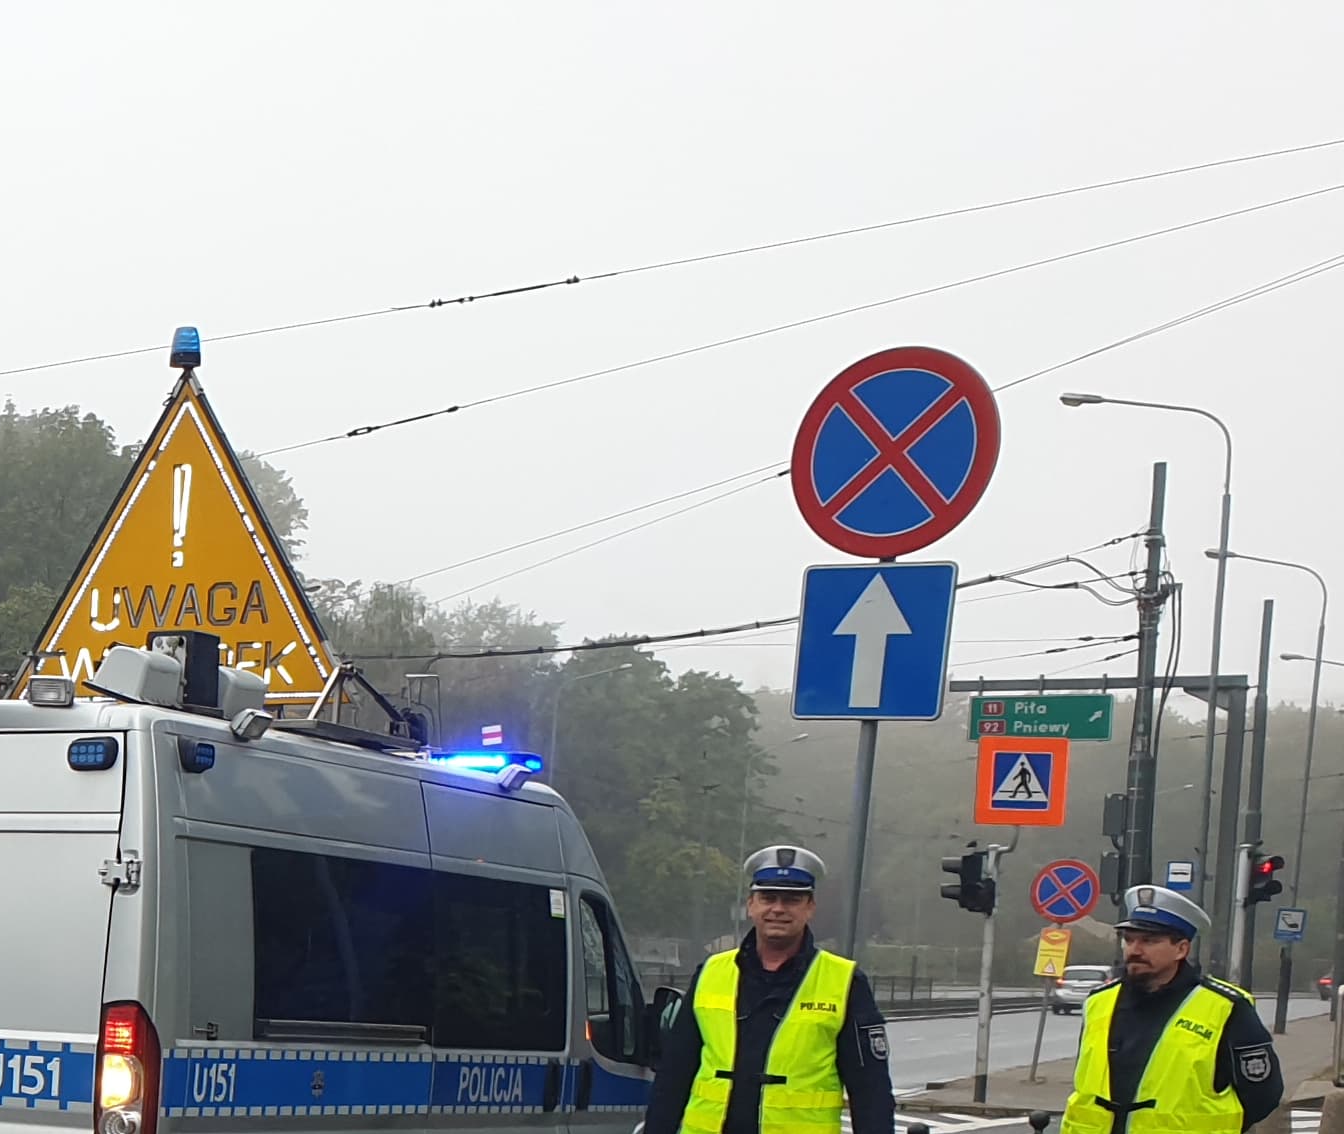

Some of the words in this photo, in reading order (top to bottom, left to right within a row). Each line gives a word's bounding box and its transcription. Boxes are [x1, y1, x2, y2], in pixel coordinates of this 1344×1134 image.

[90, 580, 269, 632] UWAGA
[987, 703, 998, 714] 11
[1014, 701, 1047, 715] Piła
[983, 722, 1000, 733] 92
[1013, 720, 1070, 736] Pniewy
[193, 1062, 237, 1103] U151
[457, 1066, 523, 1103] POLICJA
